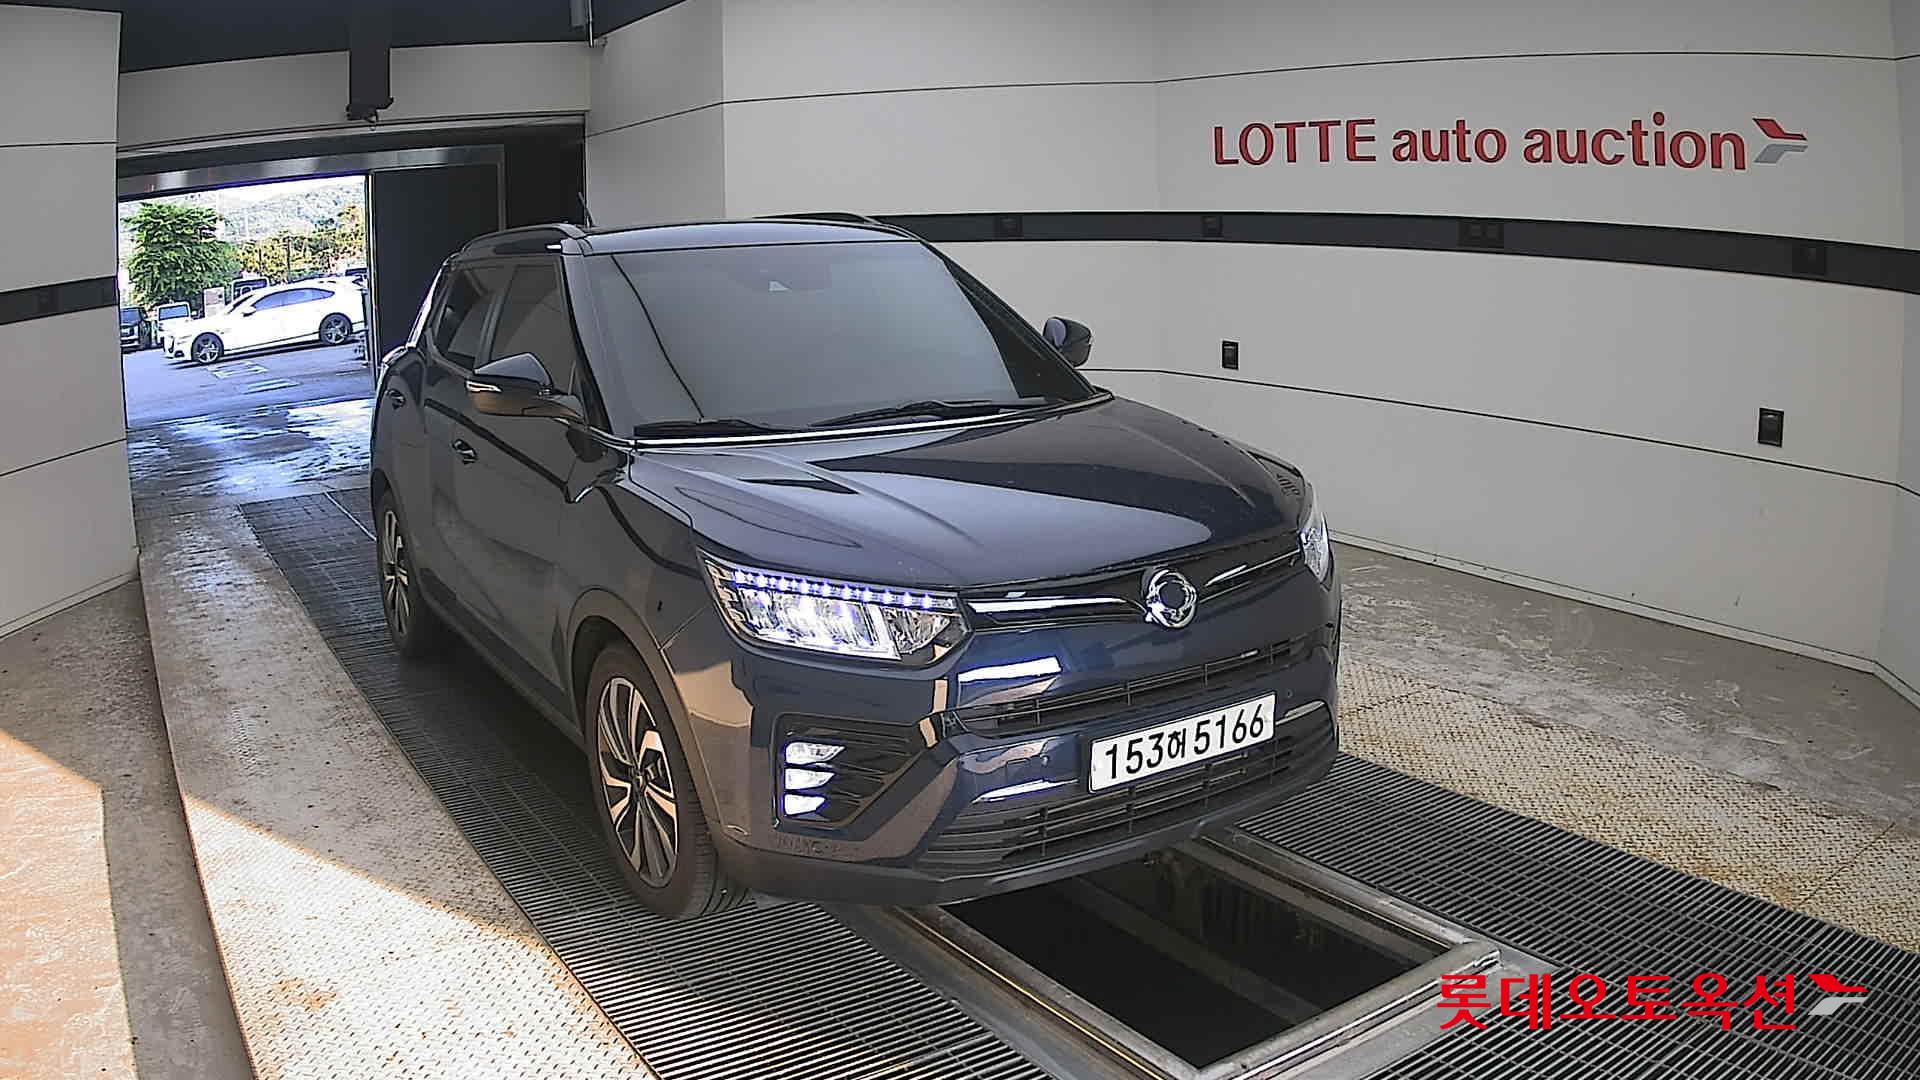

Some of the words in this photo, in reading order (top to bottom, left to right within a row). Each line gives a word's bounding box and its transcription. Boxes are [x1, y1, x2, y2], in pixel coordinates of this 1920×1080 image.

[1213, 118, 1377, 165] LOTTE
[1391, 118, 1508, 164] auto
[1522, 111, 1747, 170] auction
